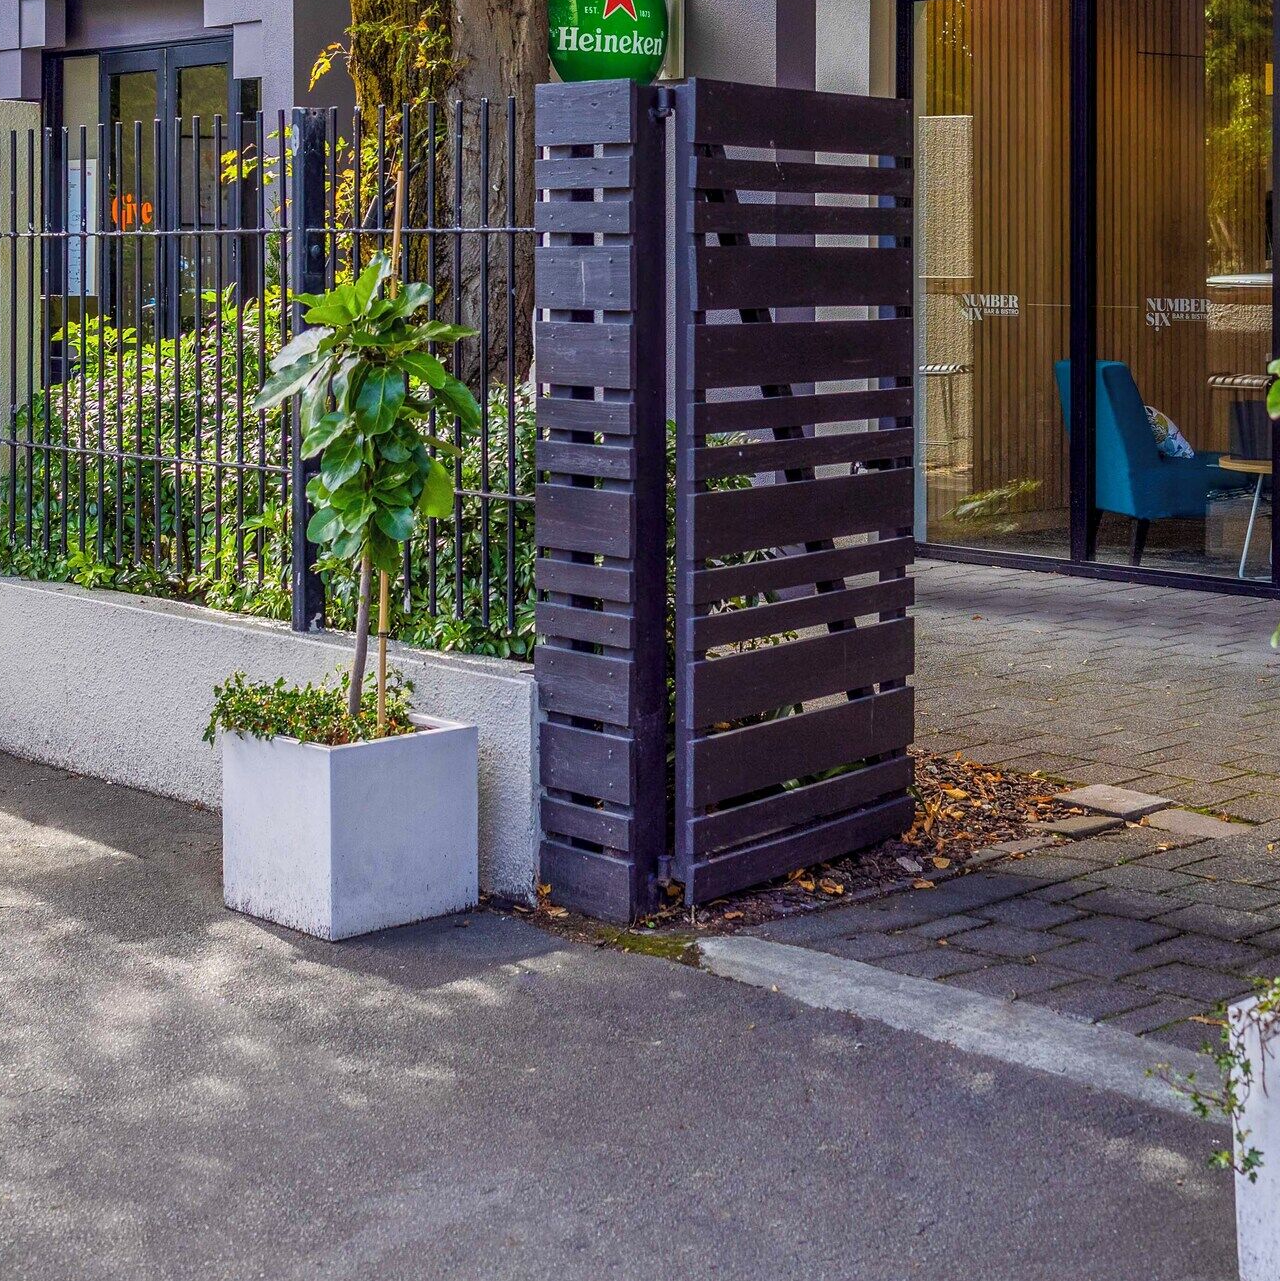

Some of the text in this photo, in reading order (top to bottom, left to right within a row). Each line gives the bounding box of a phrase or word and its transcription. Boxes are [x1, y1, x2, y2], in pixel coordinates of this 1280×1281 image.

[584, 6, 651, 18] EST. 1873
[557, 26, 663, 56] Heineken
[961, 293, 1019, 308] NUMBER
[1145, 312, 1171, 332] SIX
